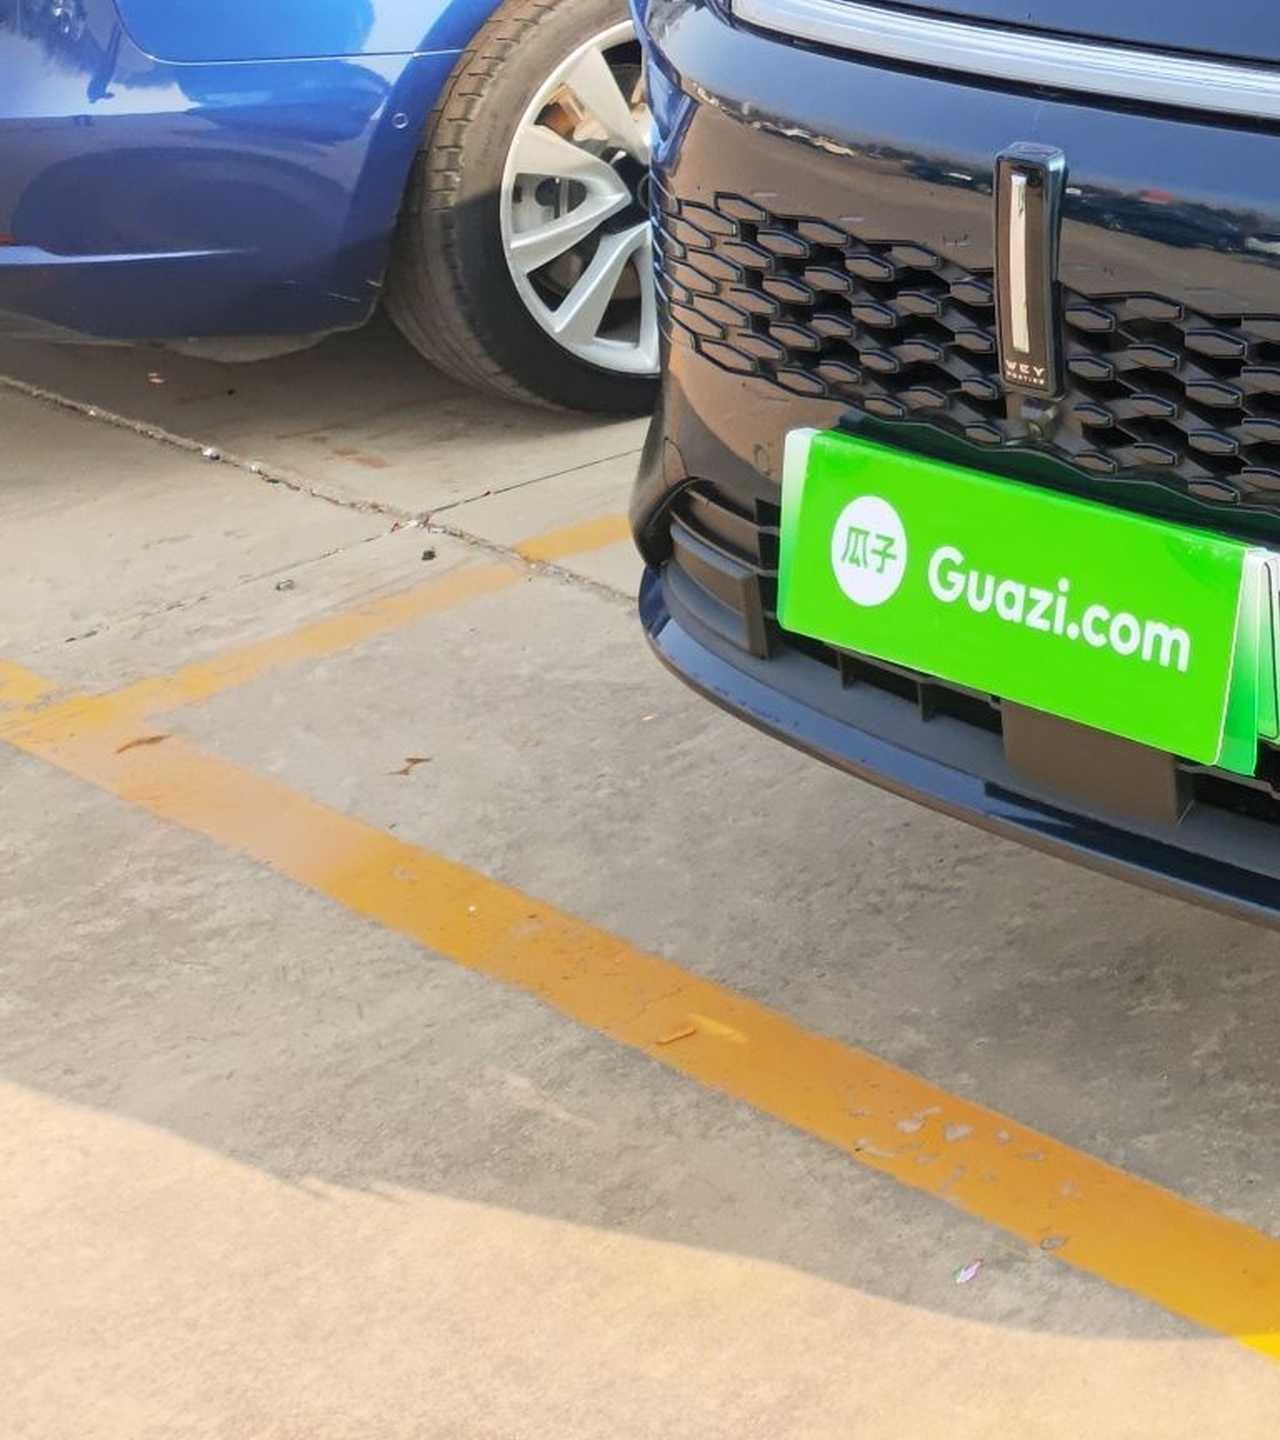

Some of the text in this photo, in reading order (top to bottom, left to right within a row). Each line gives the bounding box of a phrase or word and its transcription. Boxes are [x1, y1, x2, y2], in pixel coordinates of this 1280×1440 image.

[1006, 359, 1045, 377] WEY
[842, 526, 897, 573] 瓜子
[927, 545, 1191, 673] Guazi.com
